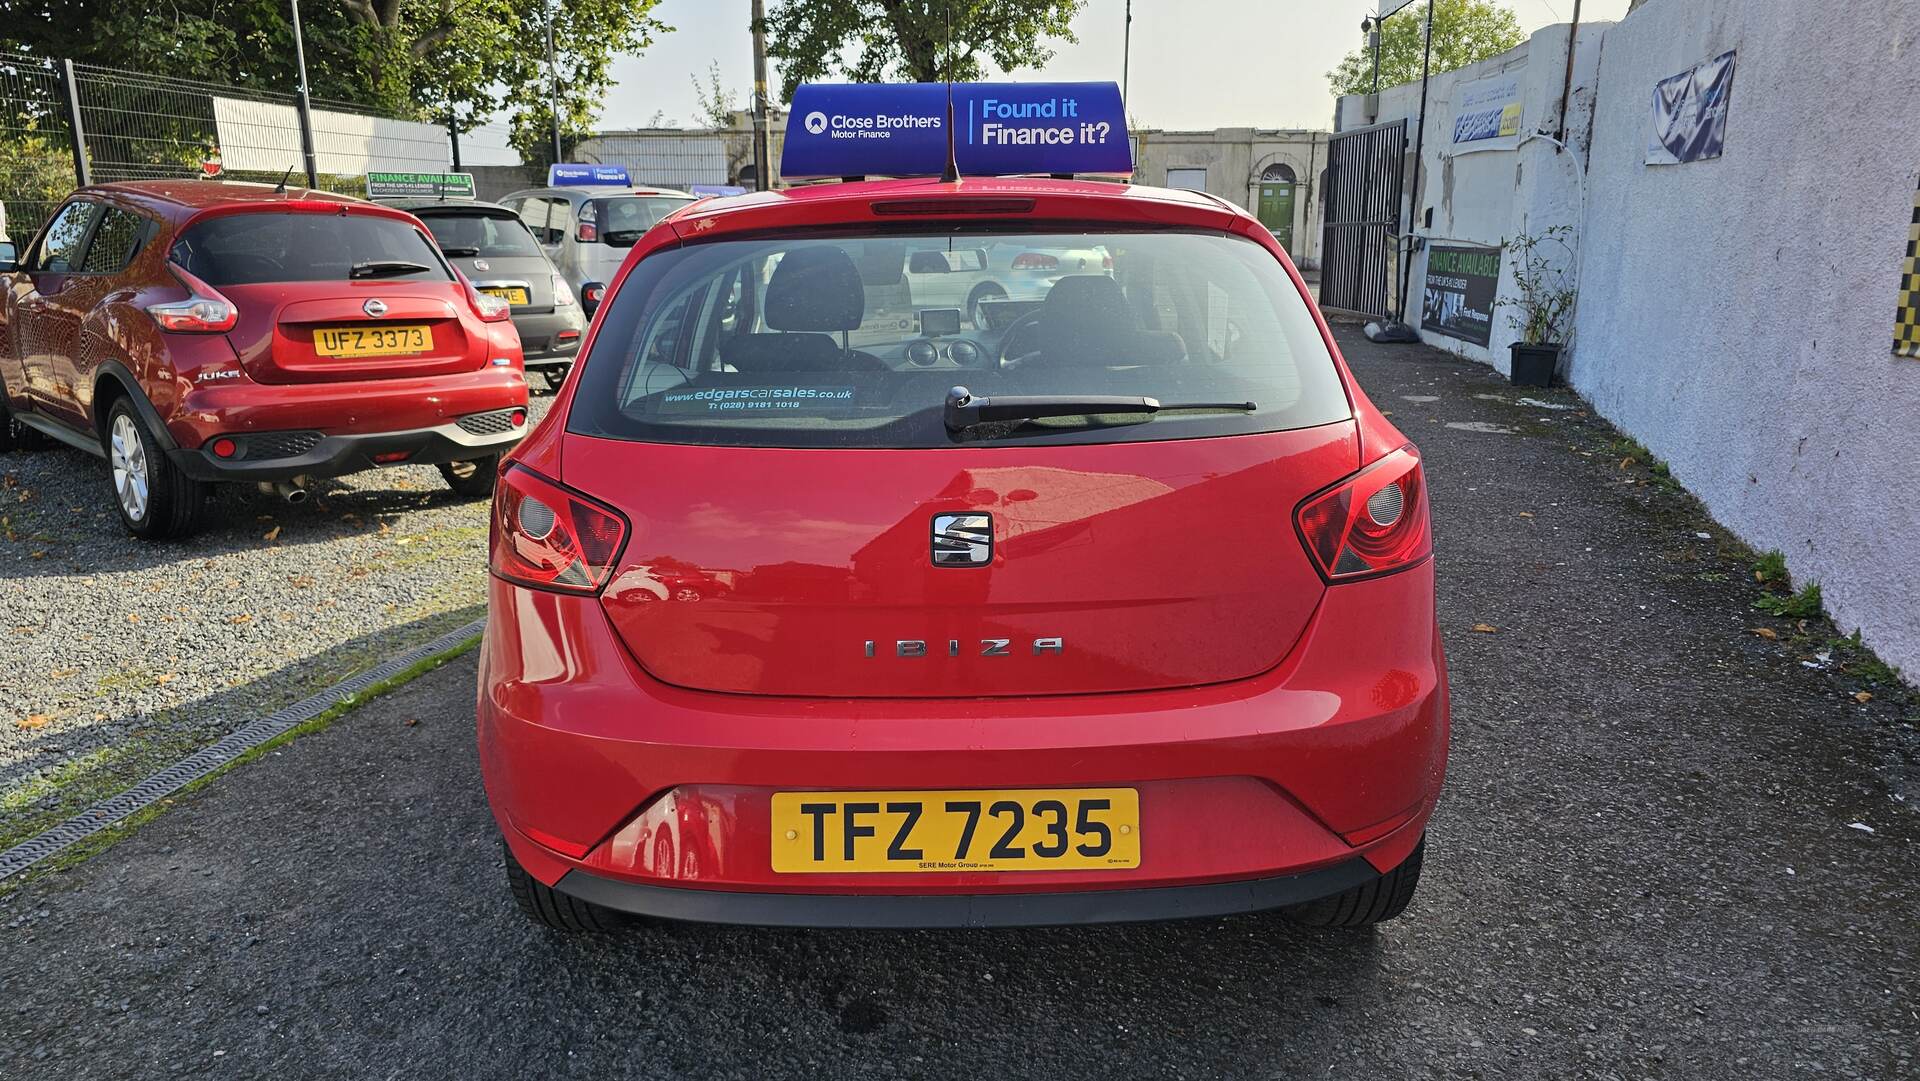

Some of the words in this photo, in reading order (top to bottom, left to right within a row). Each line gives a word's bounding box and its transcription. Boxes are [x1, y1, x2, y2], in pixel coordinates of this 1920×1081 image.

[983, 99, 1056, 118] Found
[1062, 99, 1078, 118] it
[831, 115, 873, 129] Close
[876, 115, 941, 129] Brothers
[832, 130, 856, 139] Motor
[858, 130, 891, 139] Finance
[983, 125, 1075, 146] Finance
[1080, 122, 1110, 145] it?
[369, 173, 416, 183] FINANCE
[418, 174, 471, 184] AVAILABLE
[1429, 251, 1457, 272] FINANCE
[1457, 253, 1500, 277] AVAILABLE
[323, 331, 366, 351] UFZ
[371, 329, 424, 349] 3373
[193, 369, 241, 384] JUKE
[665, 387, 852, 402] www.edgarscarsales.co.uk
[720, 402, 745, 410] (028)
[864, 637, 1064, 657] IBIZA
[801, 801, 923, 862] TFZ
[945, 799, 1112, 860] 7235
